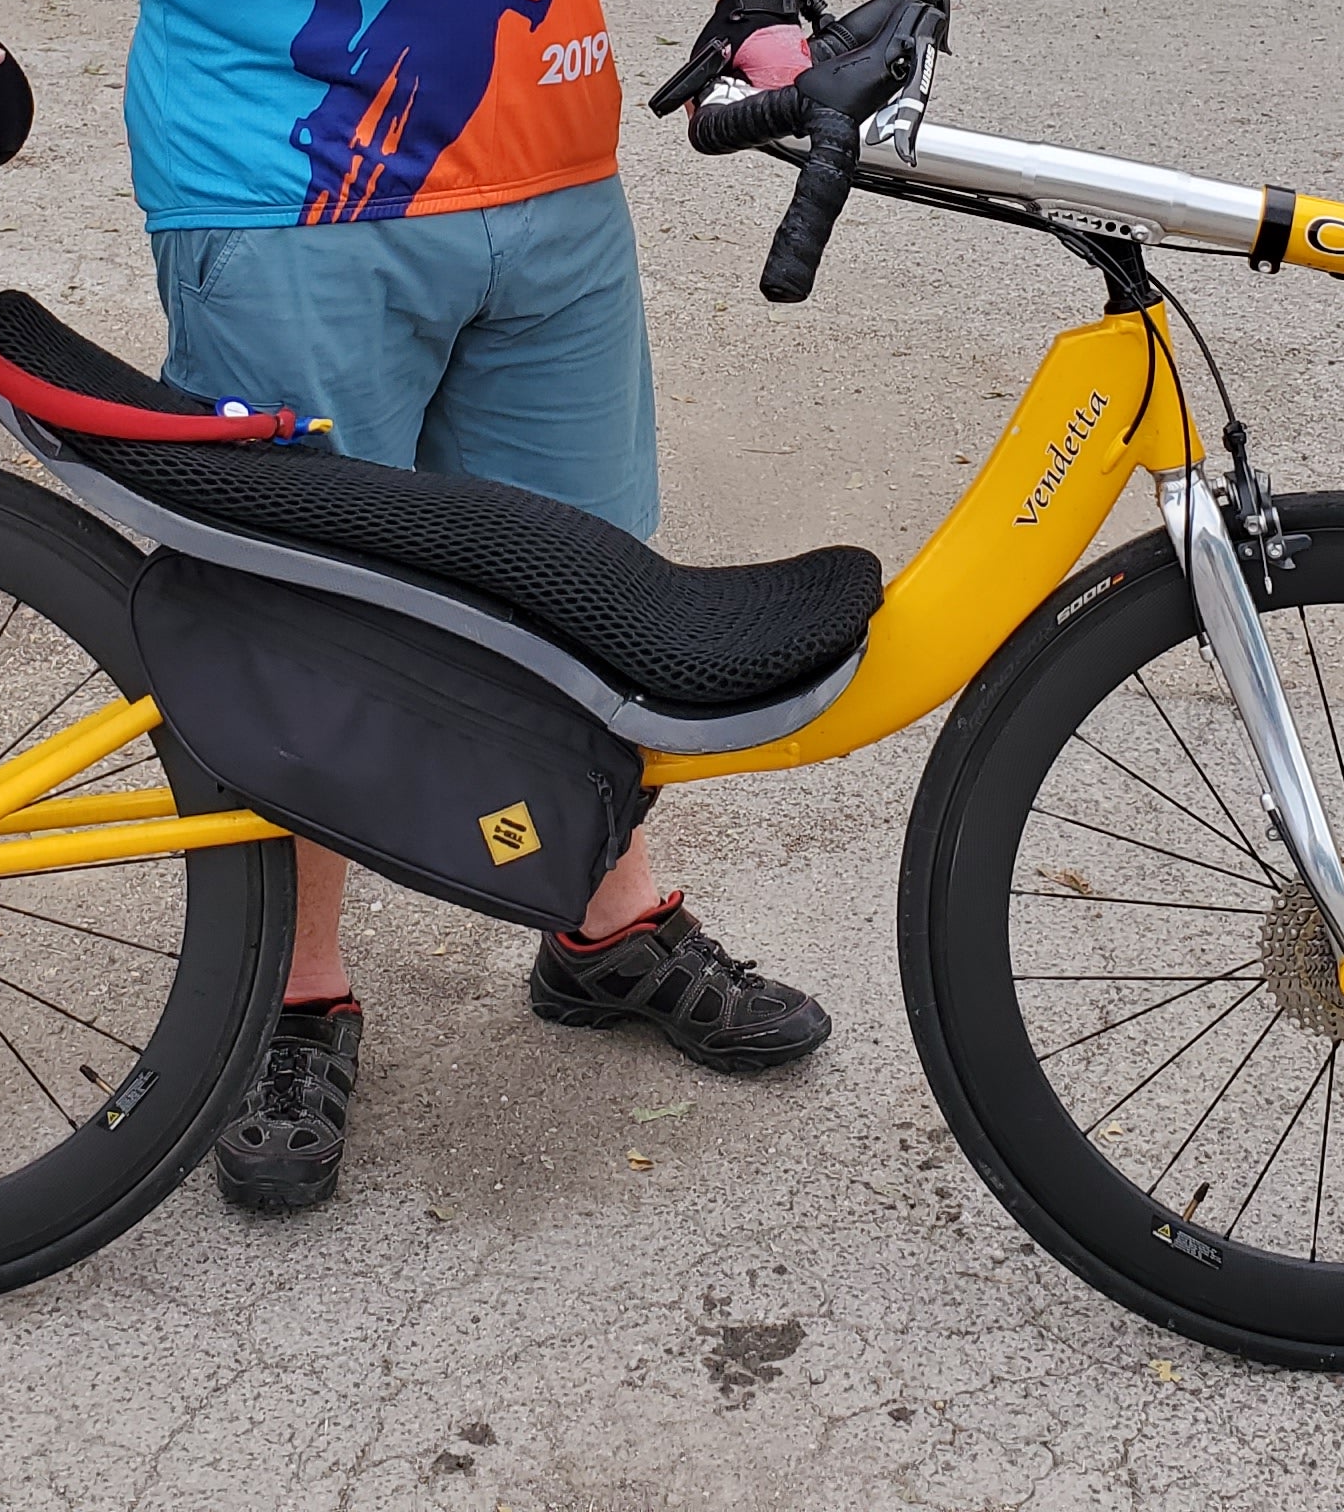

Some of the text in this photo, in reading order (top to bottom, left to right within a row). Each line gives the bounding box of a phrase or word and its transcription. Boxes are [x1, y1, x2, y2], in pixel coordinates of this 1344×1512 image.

[537, 31, 609, 86] 2019
[919, 43, 936, 95] SRAM
[1013, 389, 1110, 526] Vendetta
[1056, 576, 1112, 626] 5000
